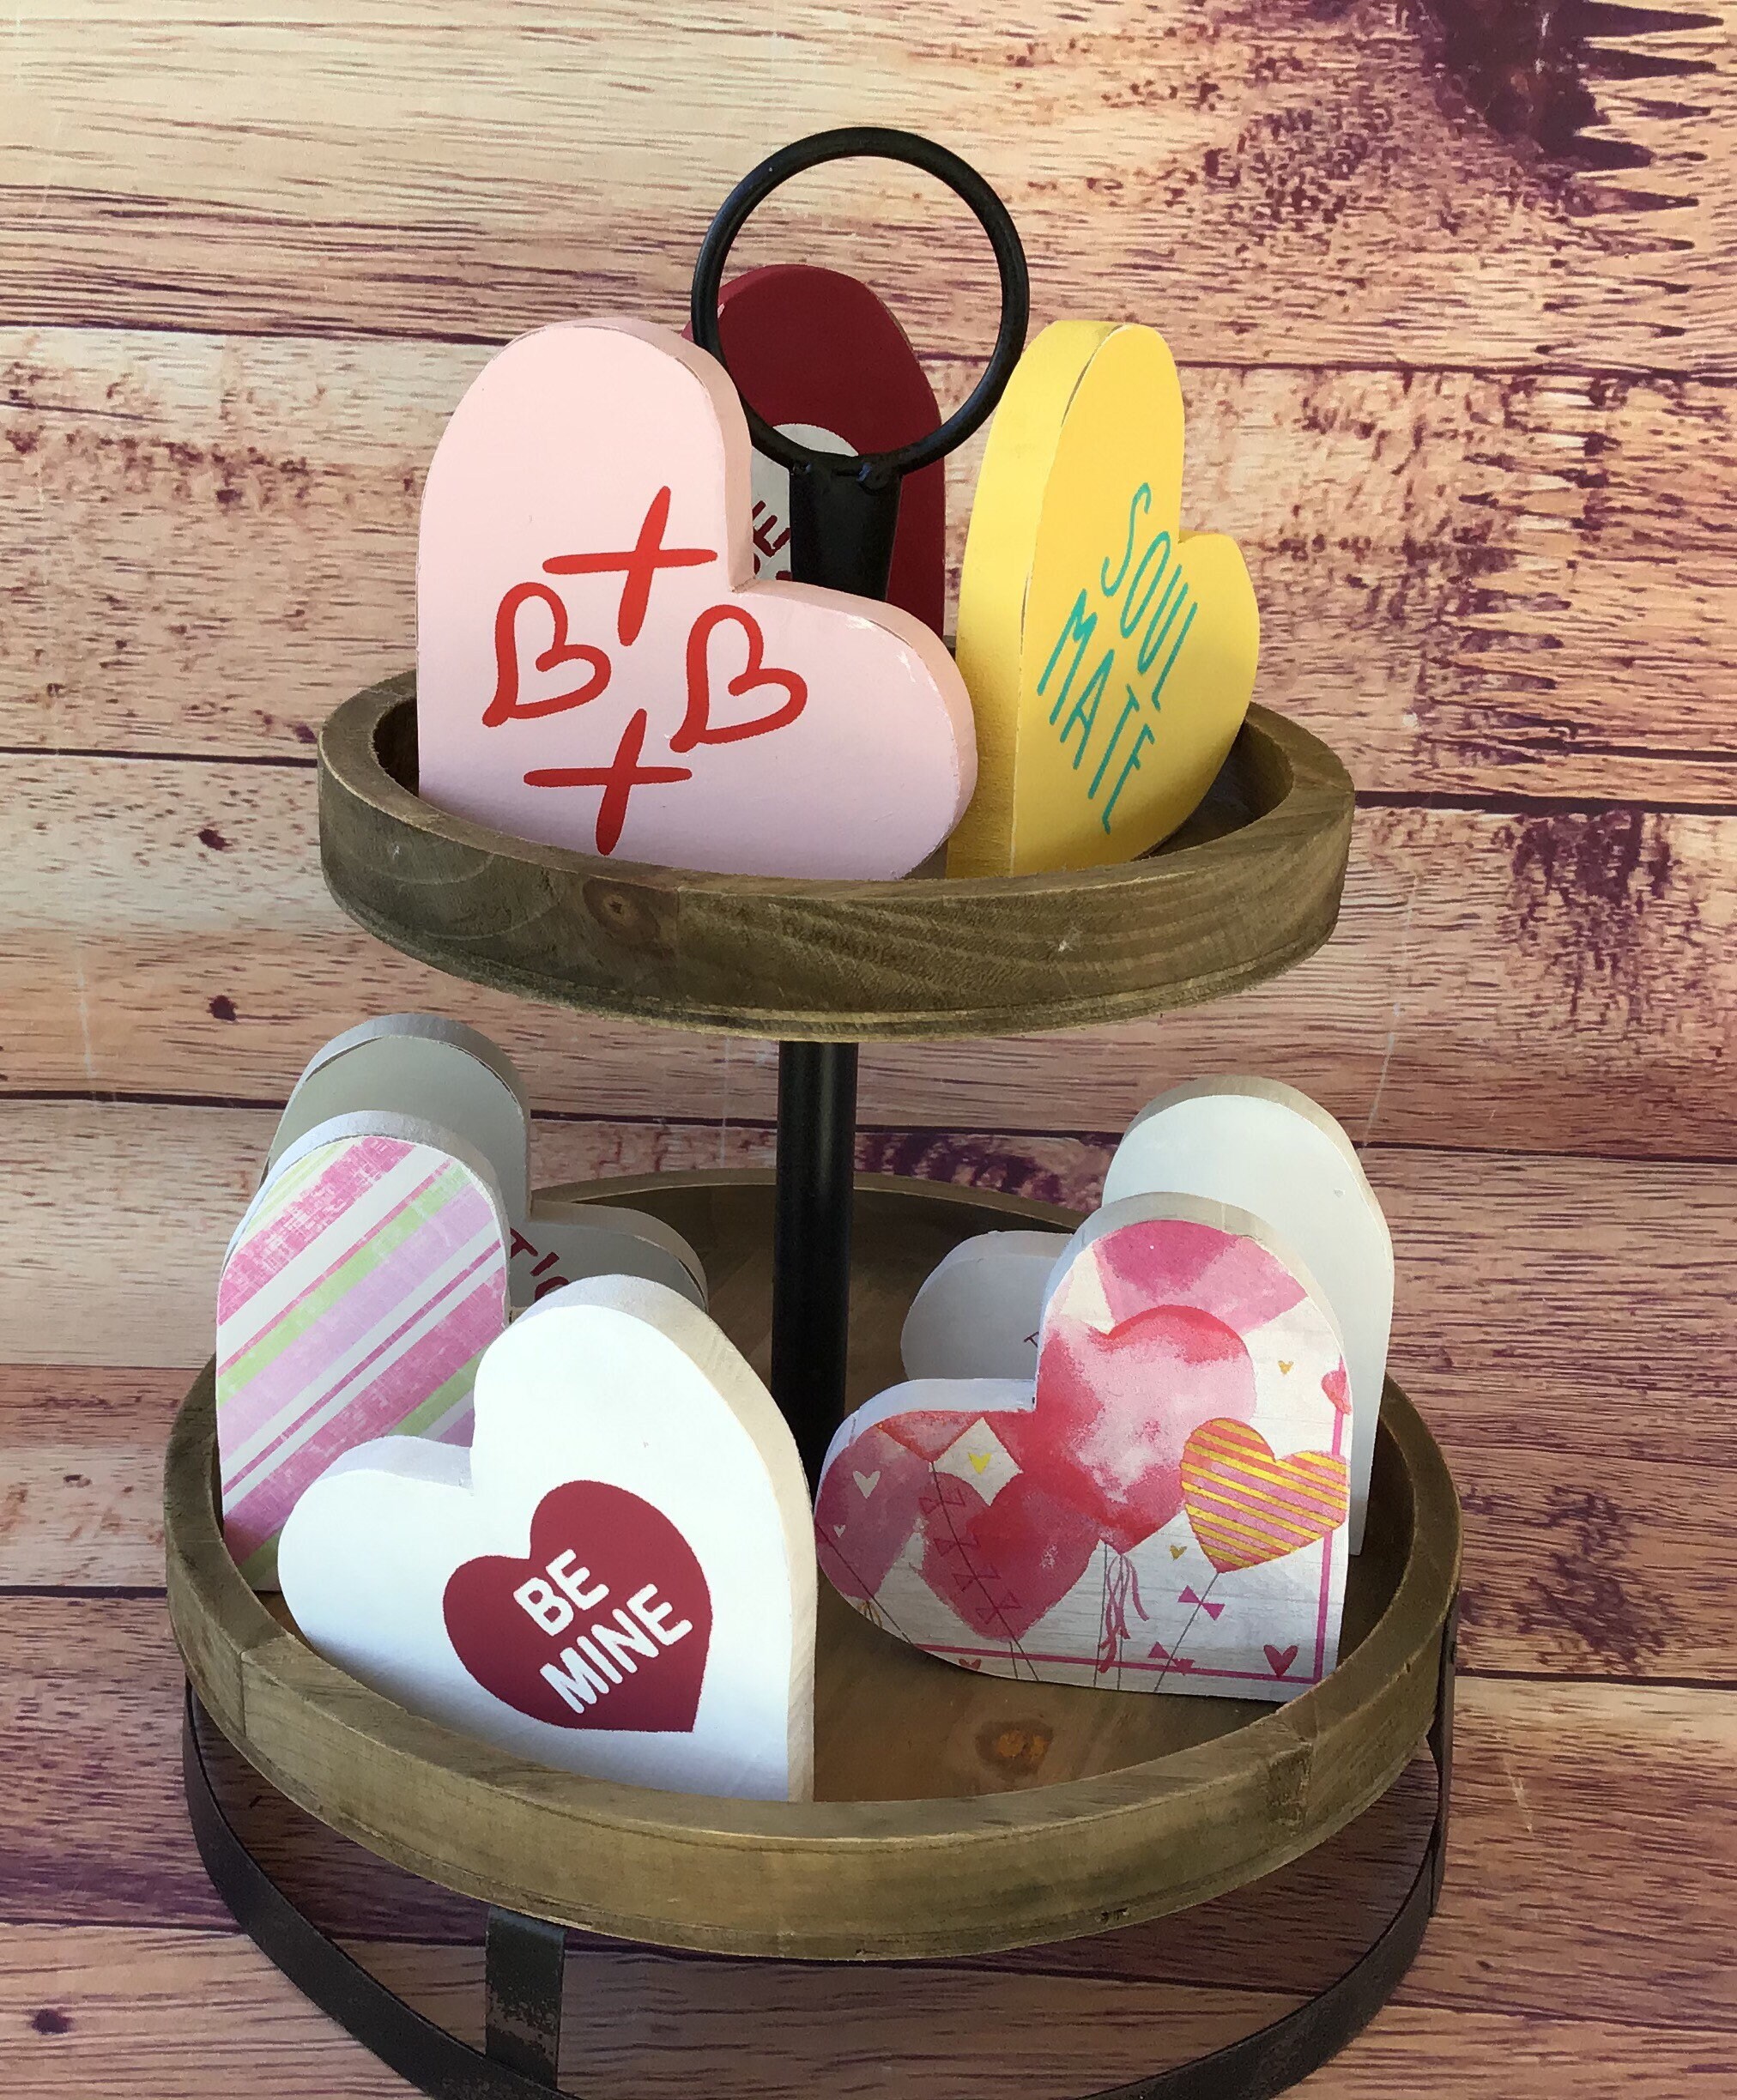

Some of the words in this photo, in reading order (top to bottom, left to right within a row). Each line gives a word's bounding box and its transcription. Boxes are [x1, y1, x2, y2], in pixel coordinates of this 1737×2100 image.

[1101, 482, 1198, 711] SOUL
[1037, 589, 1155, 835] MATE
[513, 1549, 610, 1637] BE
[540, 1583, 693, 1715] MINE
